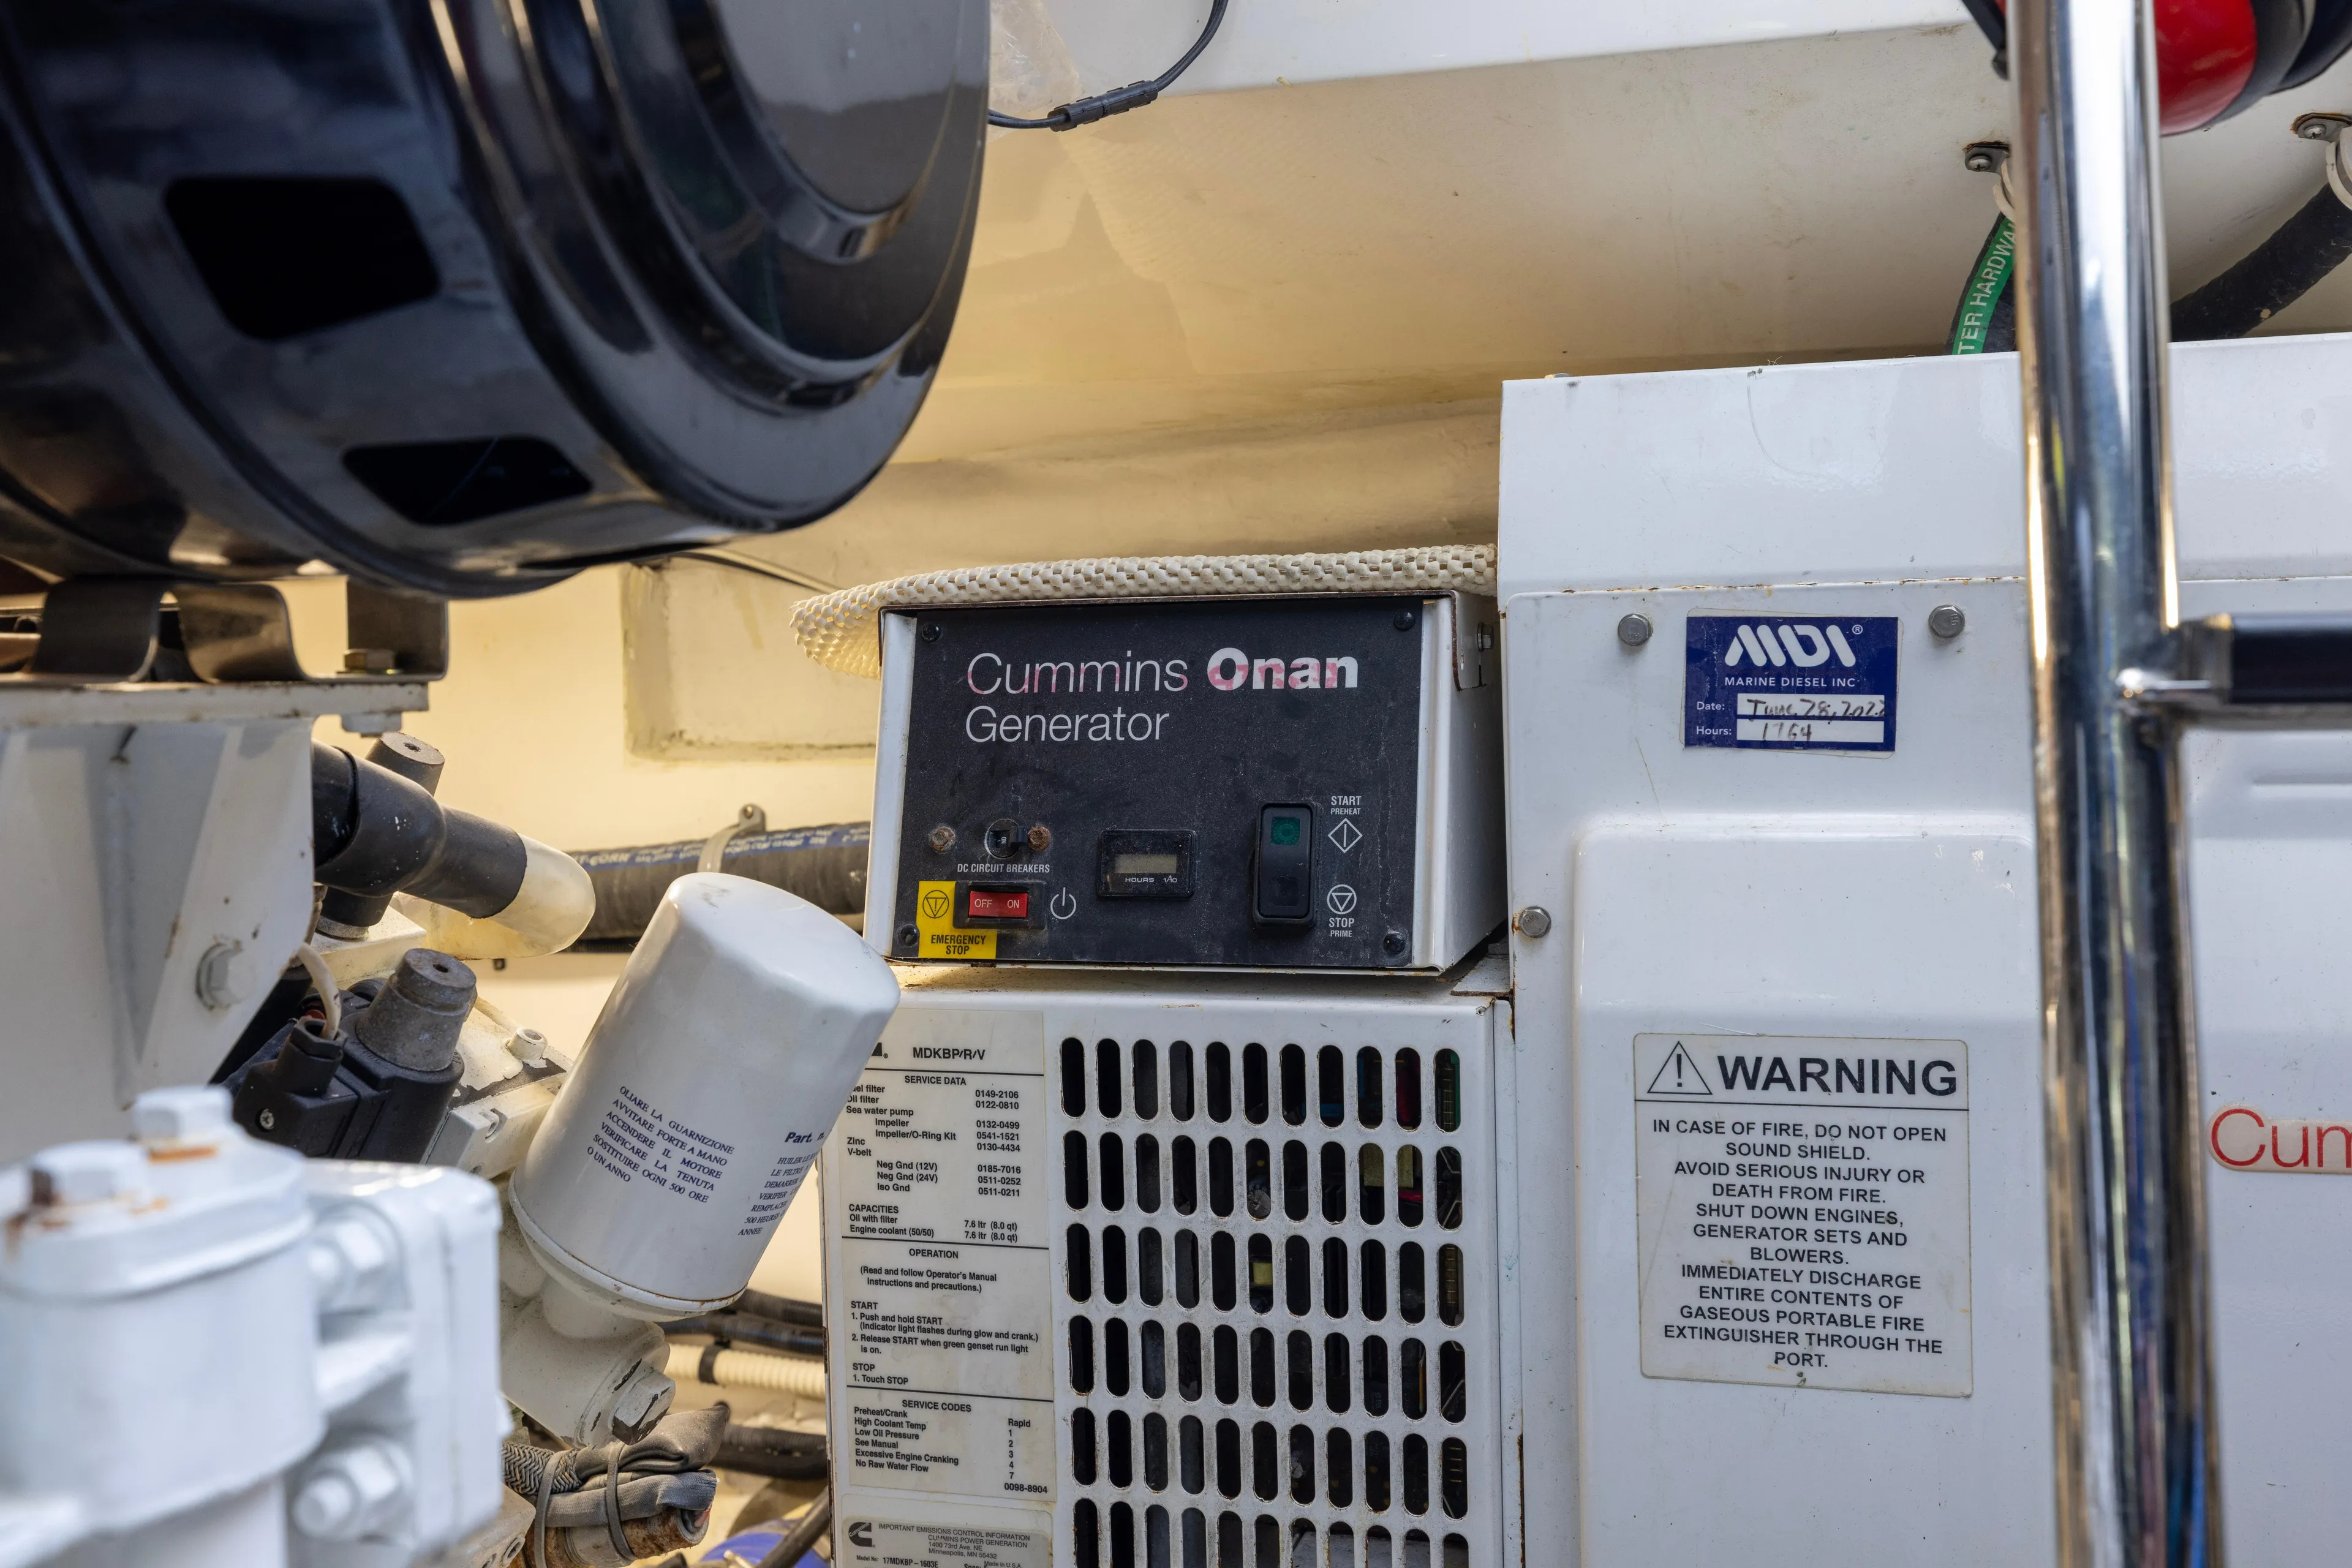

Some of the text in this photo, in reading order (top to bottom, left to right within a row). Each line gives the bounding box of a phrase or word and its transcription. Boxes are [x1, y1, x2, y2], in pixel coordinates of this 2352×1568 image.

[1969, 222, 2016, 306] HARDWA
[968, 647, 1358, 695] Cummins Onan
[1725, 677, 1855, 687] MARINE DIESEL INC
[1697, 701, 1725, 710] Date:
[966, 706, 1169, 742] Generator
[1697, 726, 1732, 735] Hours:
[1331, 796, 1362, 805] START
[957, 862, 1050, 873] DC CIRCUIT BREAKERS
[974, 899, 992, 908] OFF
[1007, 899, 1019, 908] ON
[1329, 917, 1354, 927] STOP
[931, 935, 987, 944] EMERGENCY
[946, 945, 970, 955] STOP
[913, 1047, 986, 1060] MDKBP/R/V
[905, 1076, 967, 1085] SERVICE DATA
[1717, 1055, 1956, 1096] WARNING
[975, 1090, 1019, 1099] 0149-2106
[976, 1100, 1019, 1109] 0122-0810
[620, 1086, 735, 1155] OLIARE LA GUARNIZIONE
[875, 1118, 909, 1128] Impeller
[976, 1120, 1020, 1129] 0132-0499
[612, 1098, 728, 1166] AVVITARE FORTE A MANO
[876, 1129, 941, 1141] Impeller/O-Ring
[976, 1131, 1019, 1140] 0541-1521
[1654, 1120, 1945, 1142] IN CASE OF FIRE, DO NOT OPEN
[606, 1110, 723, 1179] ACCENDERE IL MOTORE
[847, 1137, 865, 1145] Zinc
[847, 1148, 872, 1156] V-belt
[977, 1142, 1020, 1152] 0130-4434
[1726, 1142, 1870, 1160] SOUND SHIELD.
[600, 1122, 714, 1191] VERIFICARE LA TENUTA
[587, 1146, 631, 1182] O UN ANNO
[593, 1134, 709, 1204] SOSTITUIRE OGNI 500 ORE
[876, 1160, 937, 1172] Neg Gnd (12V)
[978, 1164, 1021, 1174] 0185-7016
[877, 1171, 938, 1183] Neg Gnd (24V)
[1675, 1161, 1924, 1183] AVOID SERIOUS INJURY OR
[978, 1176, 1021, 1185] 0511-0252
[892, 1183, 910, 1192] Gnd
[978, 1187, 1019, 1197] 0511-0211
[1713, 1183, 1885, 1203] DEATH FROM FIRE.
[849, 1204, 899, 1214] CAPACITIES
[880, 1215, 897, 1224] filter
[1697, 1203, 1903, 1227] SHUT DOWN ENGINES,
[850, 1224, 876, 1235] Engine
[909, 1227, 934, 1238] (50/50)
[990, 1221, 1005, 1231] (8.0
[1007, 1223, 1017, 1232] qt)
[965, 1231, 976, 1239] 7.6
[991, 1232, 1005, 1242] (8.0
[1007, 1234, 1017, 1243] qt)
[1694, 1224, 1907, 1246] GENERATOR SETS AND
[909, 1248, 958, 1259] OPERATION
[1751, 1247, 1849, 1264] BLOWERS.
[861, 1265, 882, 1275] (Read
[900, 1268, 924, 1277] follow
[926, 1269, 967, 1280] Operator's
[969, 1272, 997, 1281] Manual
[1682, 1264, 1921, 1289] IMMEDIATELY DISCHARGE
[1699, 1286, 1903, 1309] ENTIRE CONTENTS OF
[851, 1300, 878, 1310] START
[1680, 1305, 1924, 1332] GASEOUS PORTABLE FIRE
[1664, 1325, 1942, 1354] EXTINGUISHER THROUGH THE
[1774, 1352, 1828, 1367] PORT.
[853, 1363, 875, 1371] STOP
[861, 1374, 885, 1384] Touch
[887, 1376, 908, 1385] STOP
[902, 1400, 971, 1412] SERVICE CODES
[854, 1406, 908, 1418] Preheat/Crank
[1008, 1418, 1031, 1428] Rapid
[1004, 1482, 1048, 1493] 0098-8904
